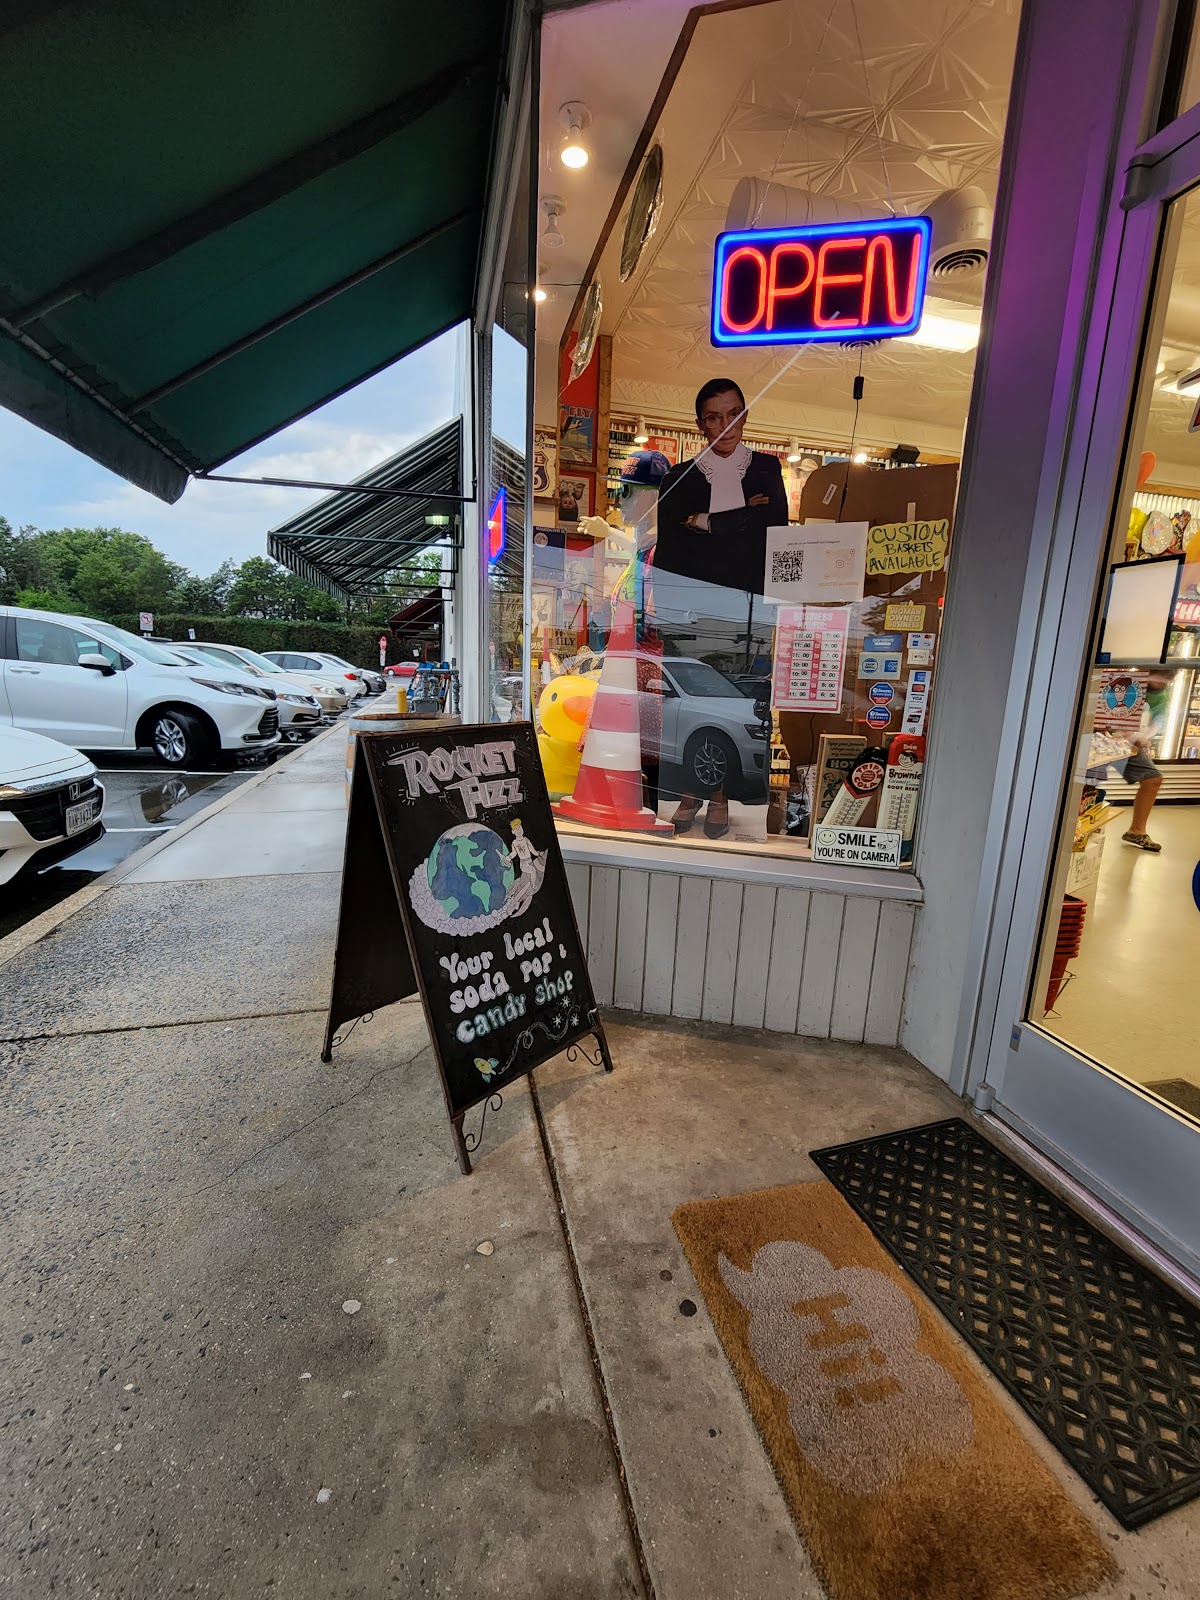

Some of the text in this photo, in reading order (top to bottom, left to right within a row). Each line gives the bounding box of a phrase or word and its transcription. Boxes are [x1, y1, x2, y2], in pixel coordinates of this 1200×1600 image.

[721, 233, 922, 333] OPEN
[568, 406, 593, 419] FLY
[872, 522, 946, 544] CUSTOM
[882, 541, 934, 556] BASKETS
[869, 551, 942, 573] AVAILABLE
[889, 614, 920, 622] OWNED
[890, 607, 922, 615] WOMAN
[387, 740, 517, 797] ROCKET
[855, 763, 883, 779] TRIPLE
[888, 768, 923, 780] Brownie
[854, 776, 878, 789] COLA
[444, 776, 523, 819] FIZZ
[837, 832, 877, 848] SMILE
[817, 847, 896, 863] YOU'RE ON CAMERA
[439, 917, 554, 984] Your local
[449, 971, 510, 1014] soda
[456, 969, 573, 1043] candy shop
[791, 1293, 906, 1408] Hi!
